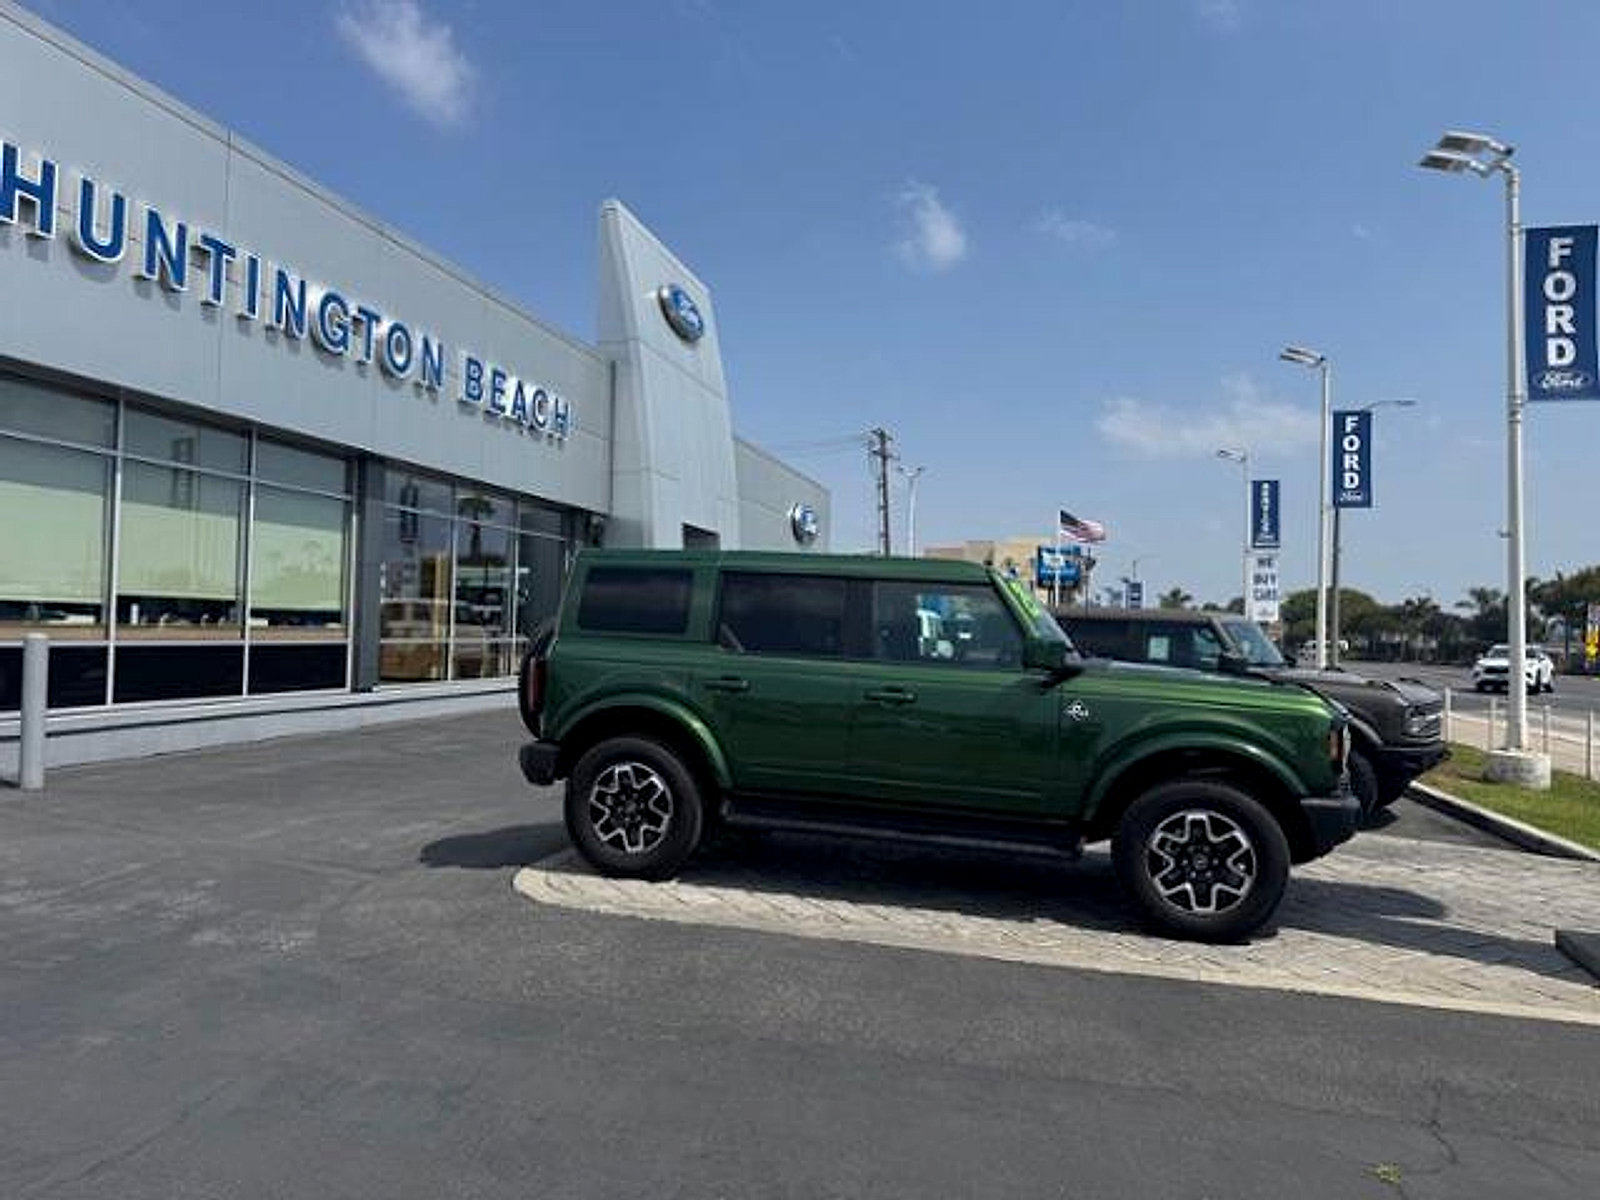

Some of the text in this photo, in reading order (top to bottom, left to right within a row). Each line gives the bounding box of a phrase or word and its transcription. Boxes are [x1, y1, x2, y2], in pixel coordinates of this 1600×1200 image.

[0, 140, 571, 440] HUNTINGTON BEACH
[1543, 237, 1577, 367] FORD
[1342, 415, 1361, 489] FORD
[1253, 573, 1277, 585] BUY
